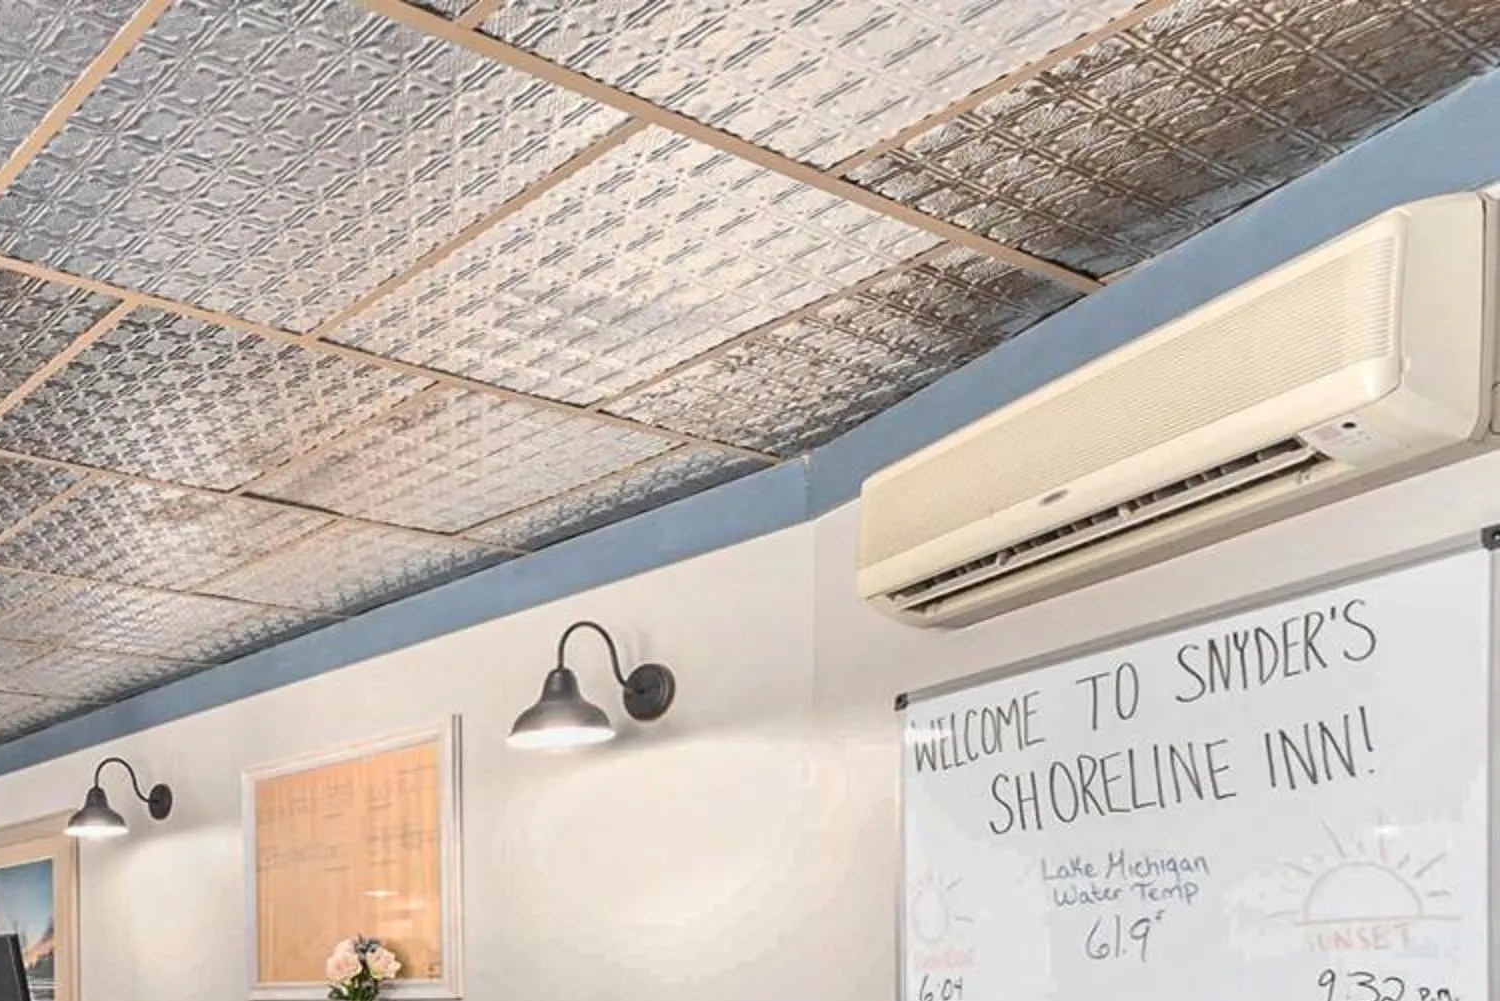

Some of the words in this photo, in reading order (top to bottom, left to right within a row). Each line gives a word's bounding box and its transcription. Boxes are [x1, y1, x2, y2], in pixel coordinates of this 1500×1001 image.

[908, 689, 1045, 773] WELCOME
[1075, 662, 1139, 732] TO
[1175, 598, 1377, 703] SNYDER'S
[988, 738, 1237, 835] SHORELINE
[1263, 705, 1375, 791] INN!
[1041, 855, 1099, 881] Lake
[1104, 848, 1210, 886] Michigan
[1053, 882, 1123, 906] Water
[1130, 880, 1200, 905] Temp
